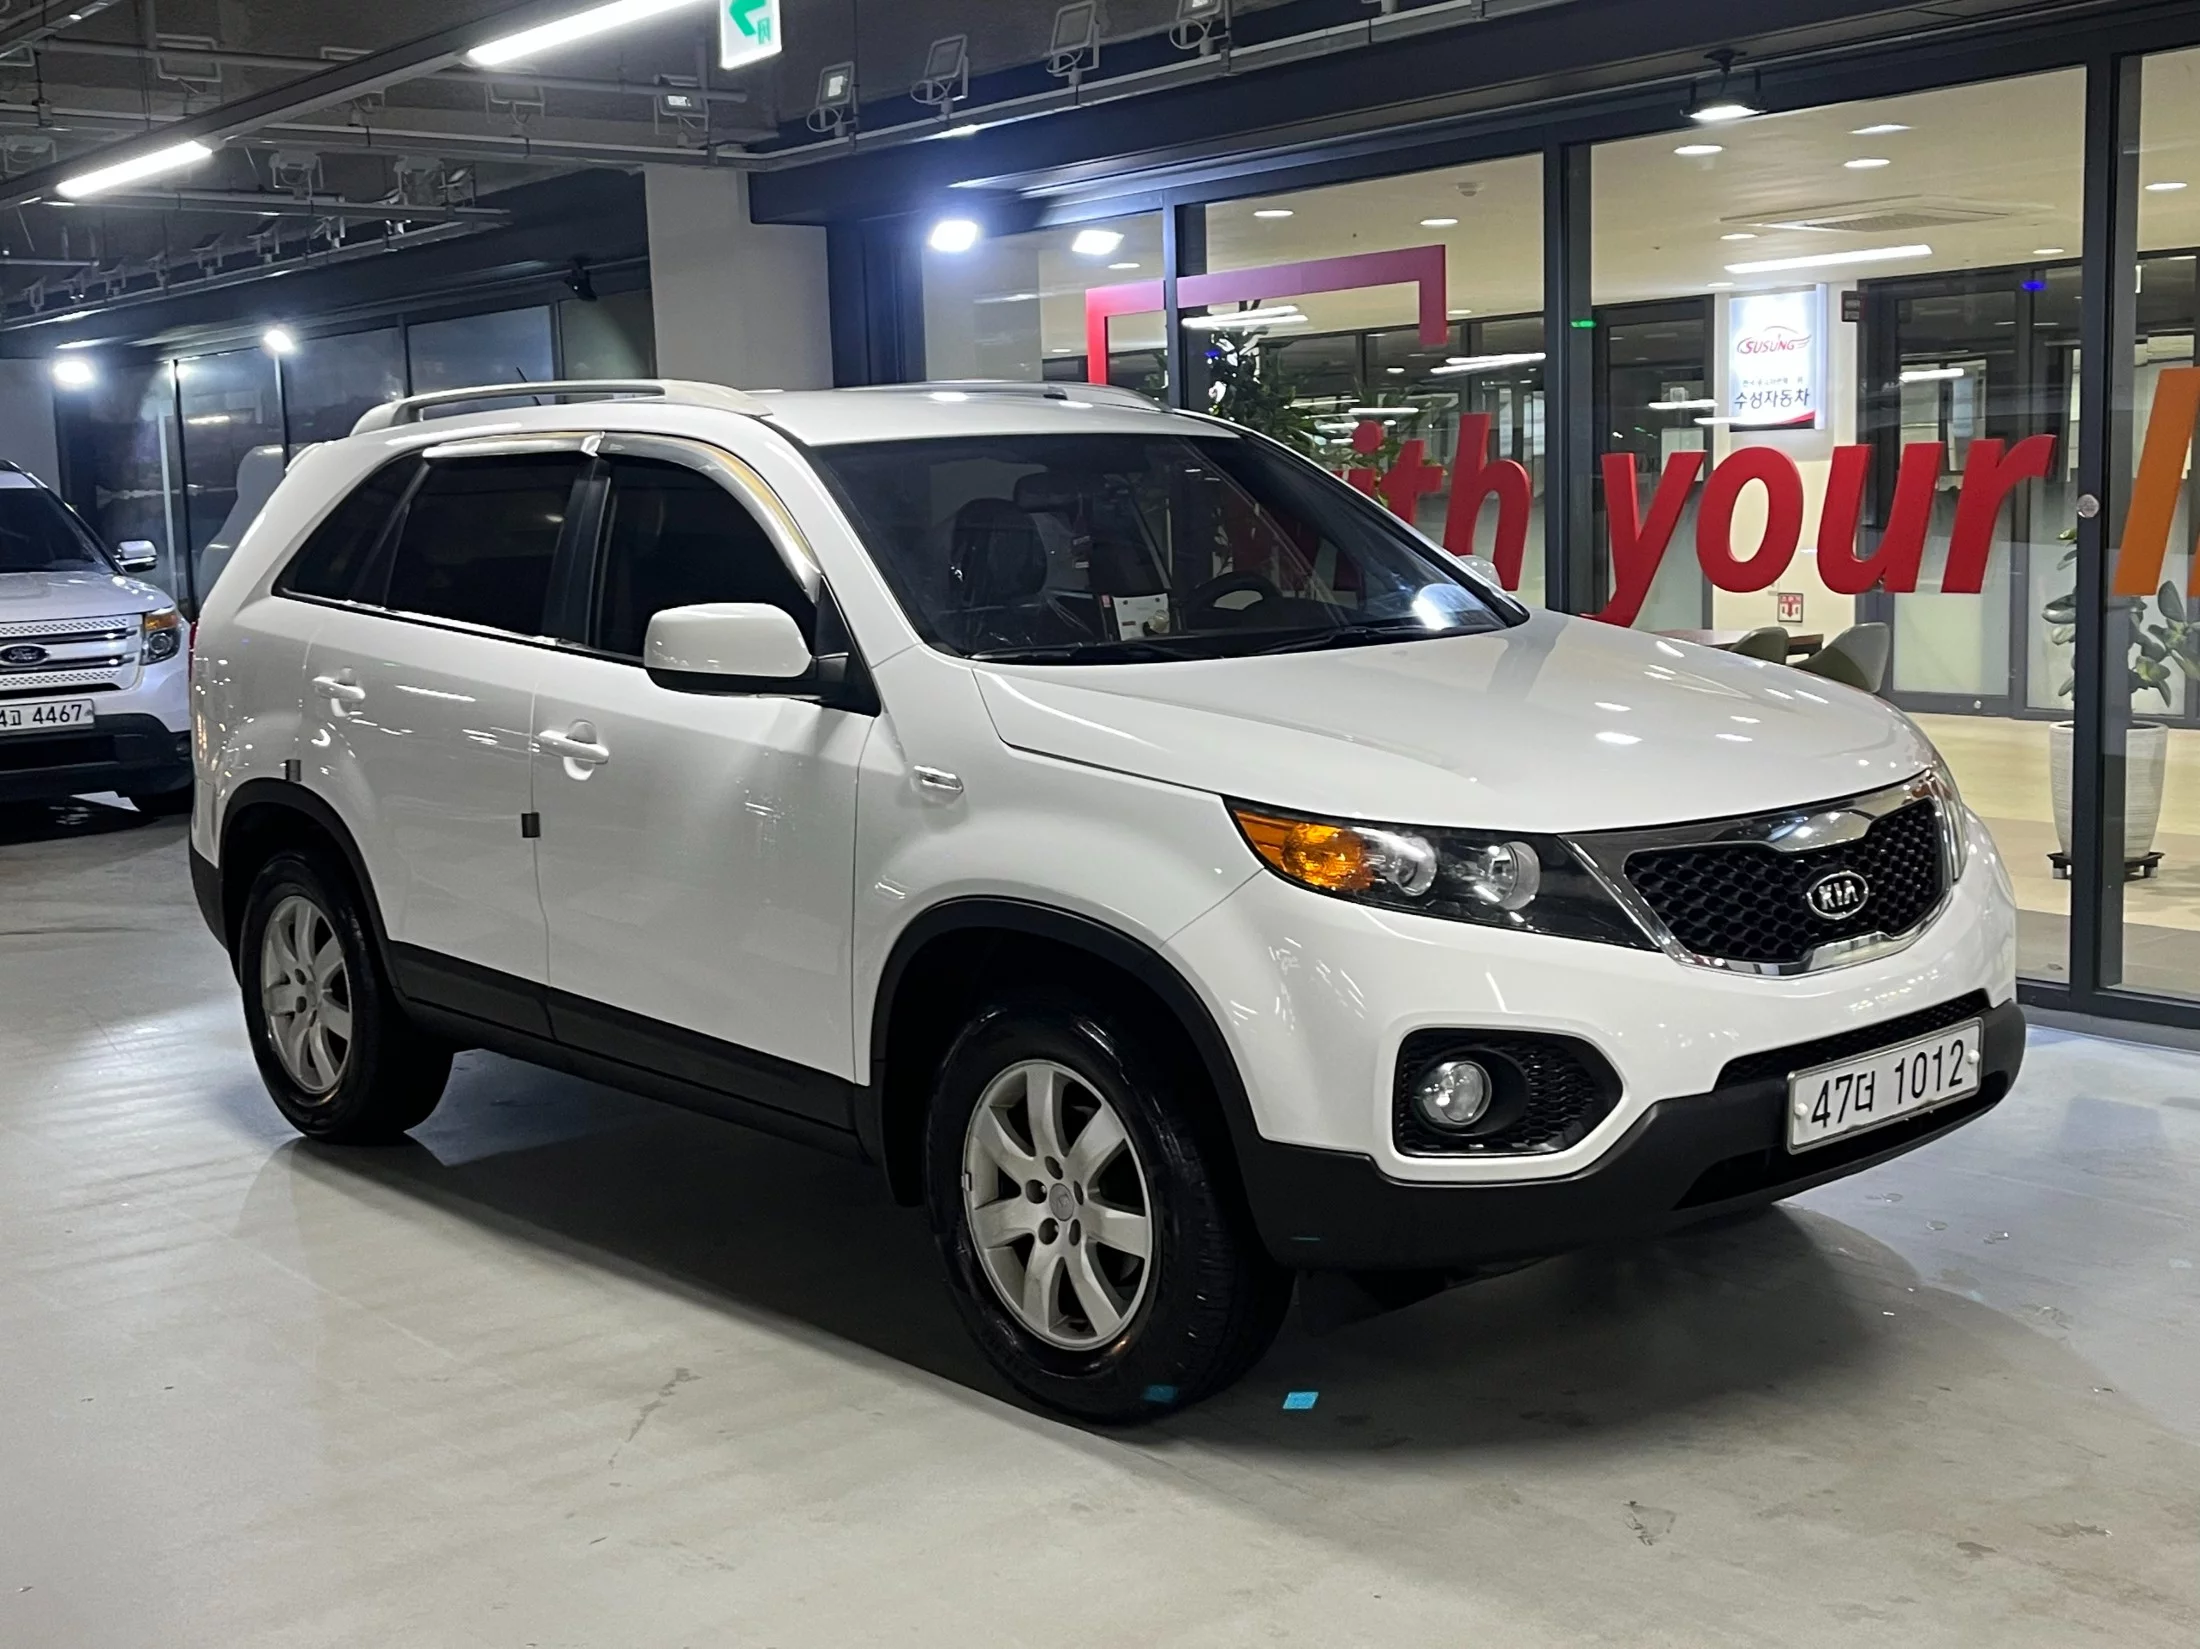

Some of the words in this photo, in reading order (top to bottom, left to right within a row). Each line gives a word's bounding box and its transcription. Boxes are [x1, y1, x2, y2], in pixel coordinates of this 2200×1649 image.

[1738, 337, 1797, 354] SUSUNG
[1734, 387, 1811, 410] 수성자동차
[1579, 434, 2056, 627] your
[32, 704, 82, 724] 4467
[1818, 879, 1859, 910] KIA
[1811, 1070, 1876, 1128] 47더
[1894, 1039, 1964, 1105] 1012
